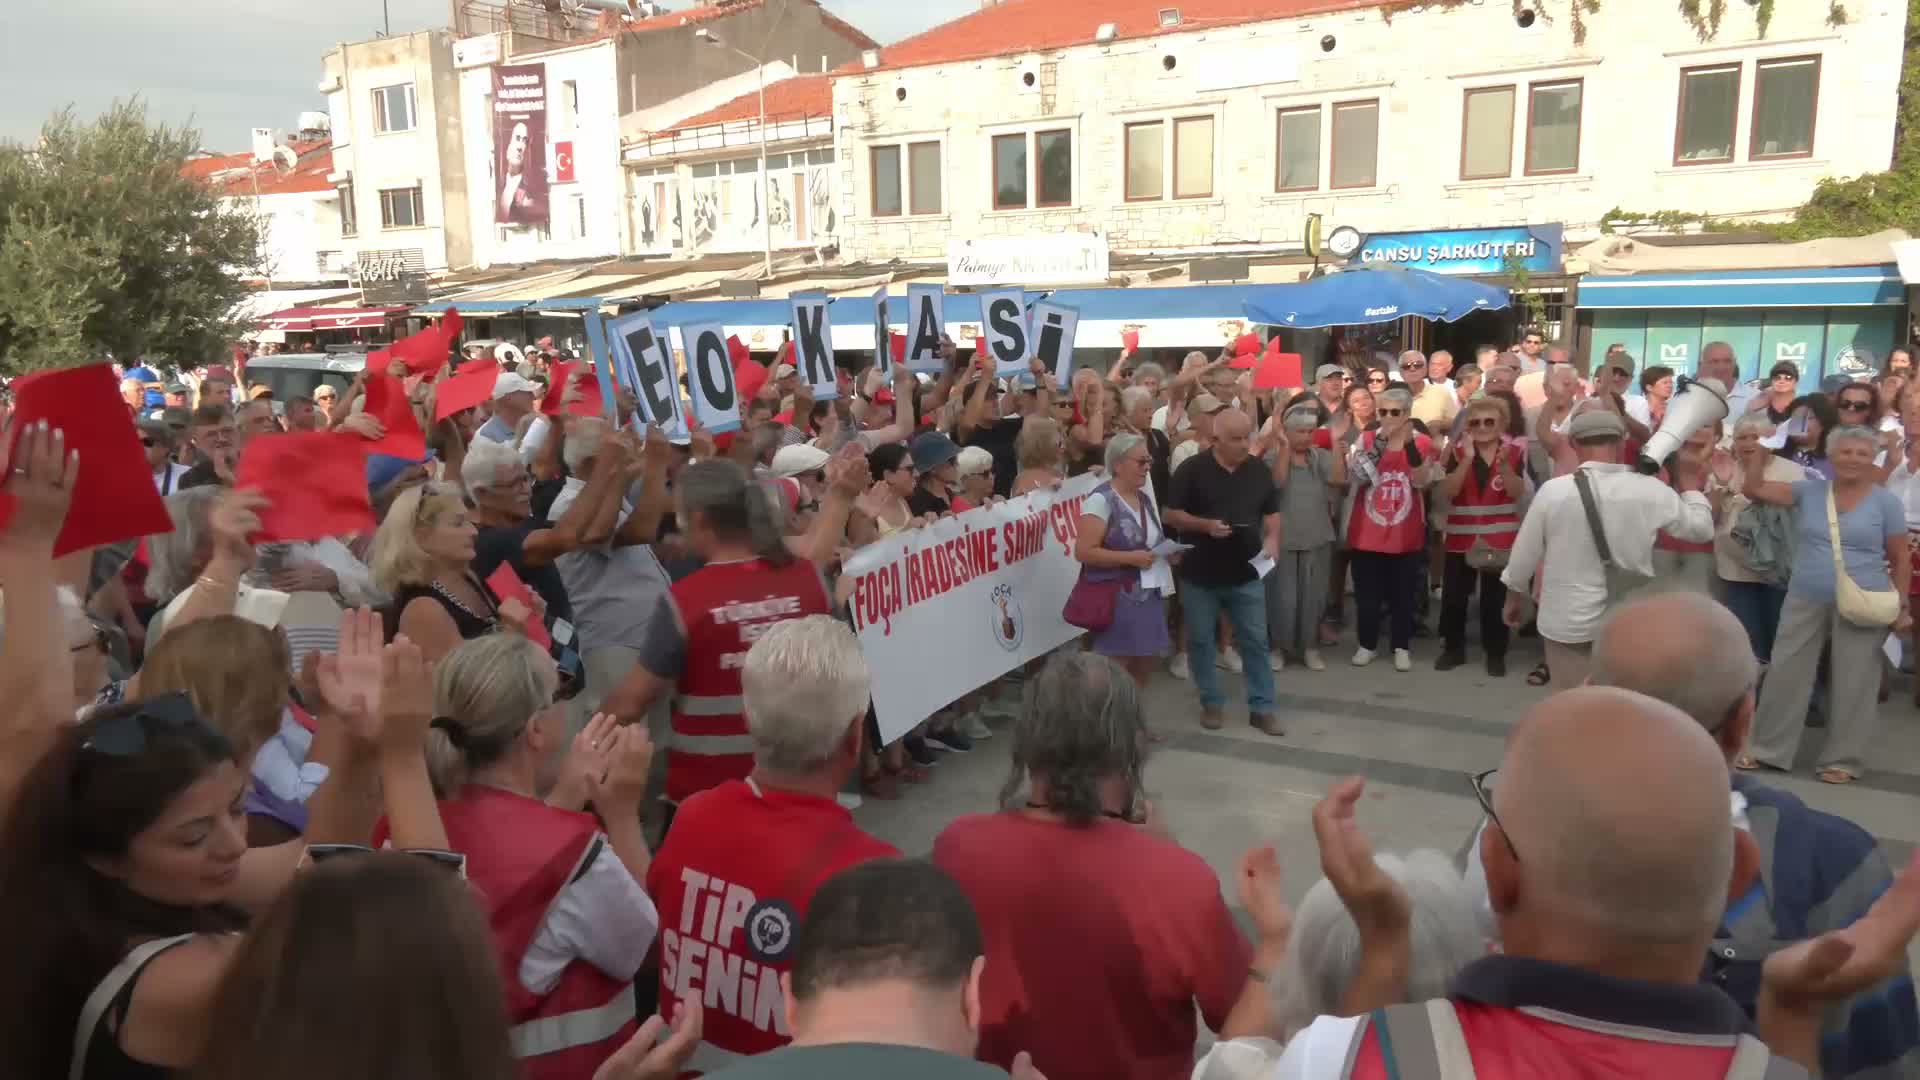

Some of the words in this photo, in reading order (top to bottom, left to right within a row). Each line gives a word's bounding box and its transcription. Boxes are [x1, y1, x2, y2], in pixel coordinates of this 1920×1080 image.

[796, 304, 835, 385] K
[988, 297, 1025, 363] S
[854, 559, 902, 636] FOÇA
[904, 523, 998, 606] İRADESİNE
[1003, 505, 1048, 565] SAHİP
